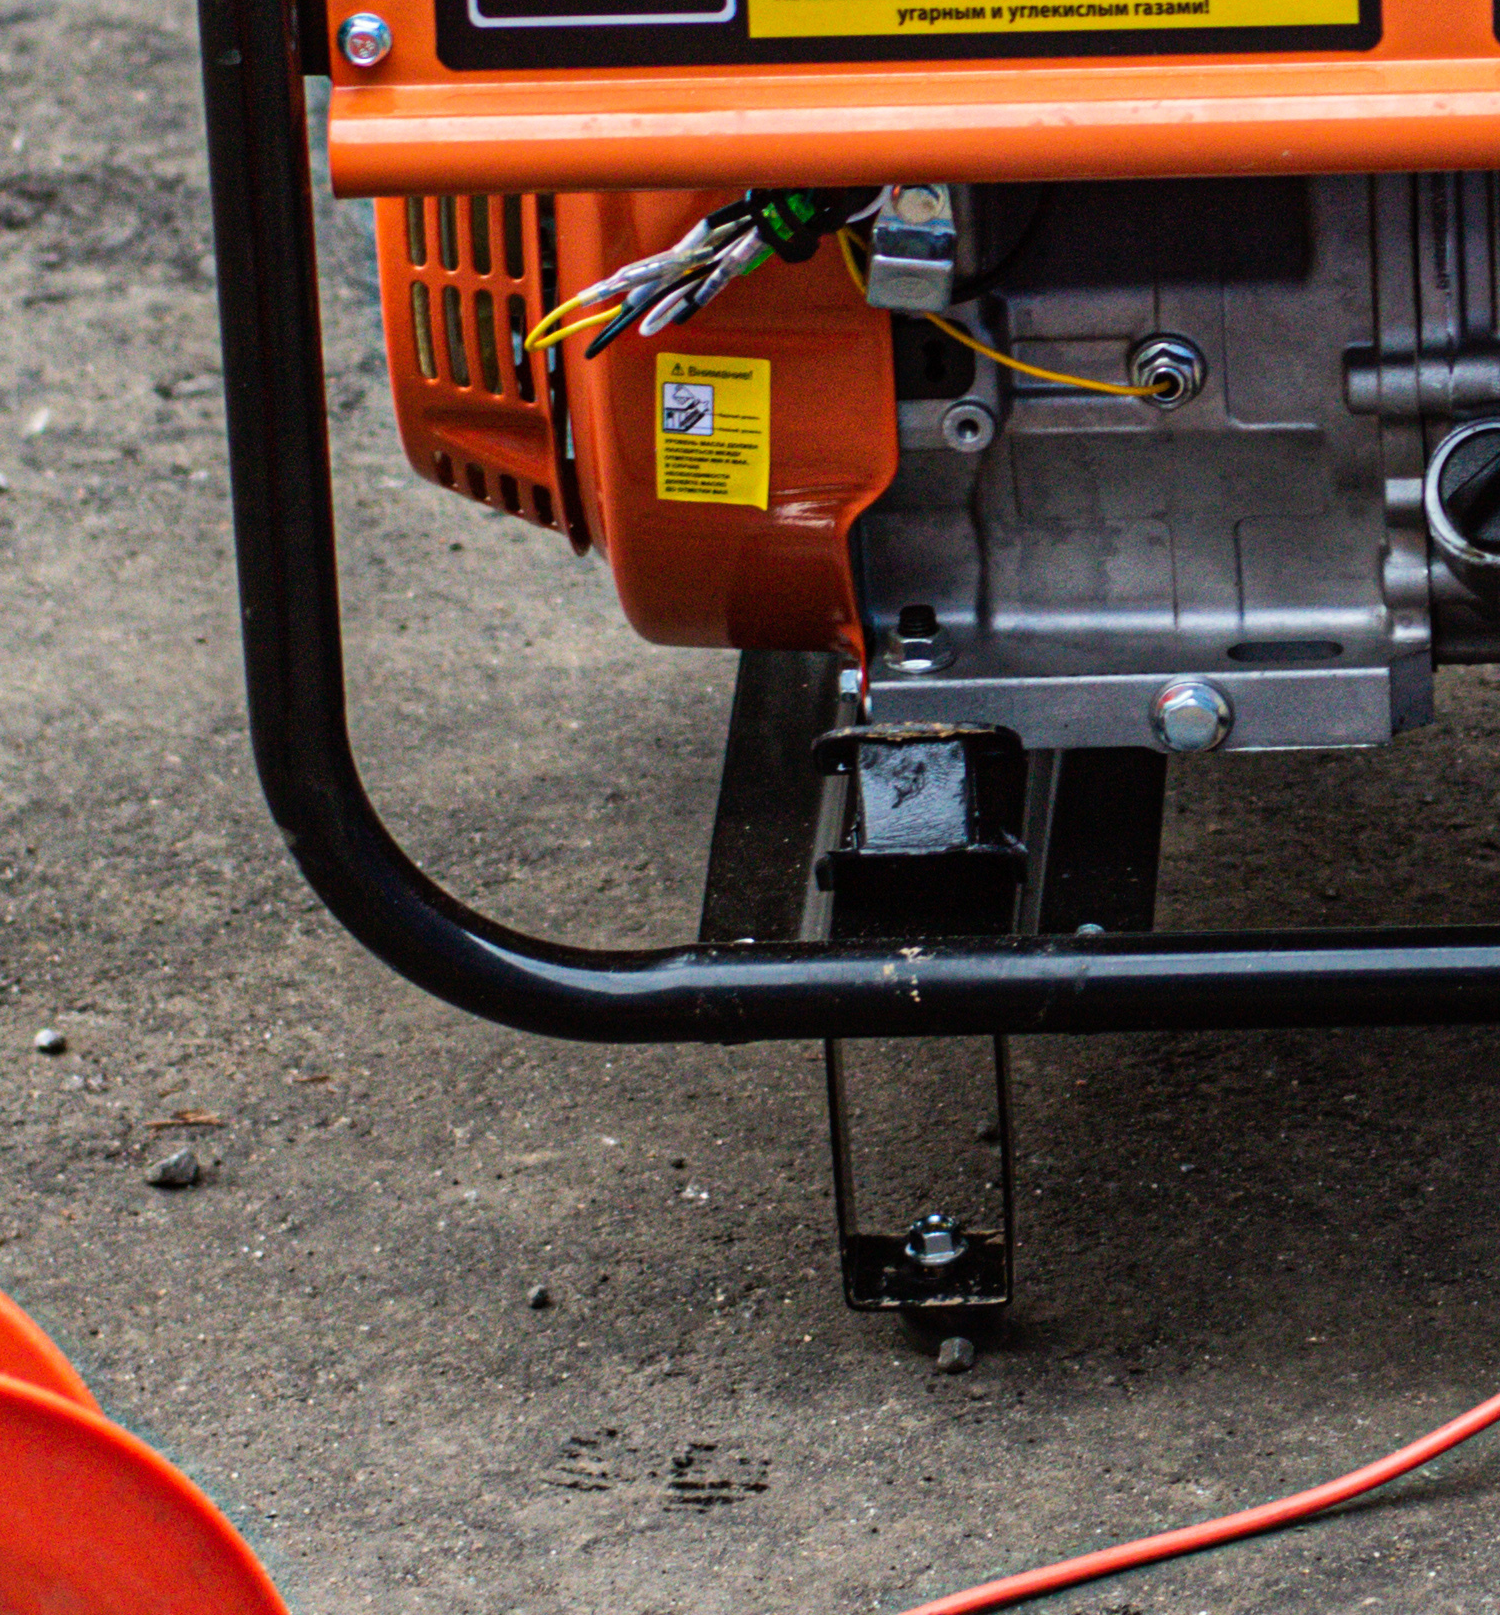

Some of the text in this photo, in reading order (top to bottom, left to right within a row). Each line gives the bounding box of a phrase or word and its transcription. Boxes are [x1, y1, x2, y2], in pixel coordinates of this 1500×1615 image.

[897, 7, 985, 26] угарным
[991, 6, 1003, 19] и
[1008, 2, 1129, 24] углекислым
